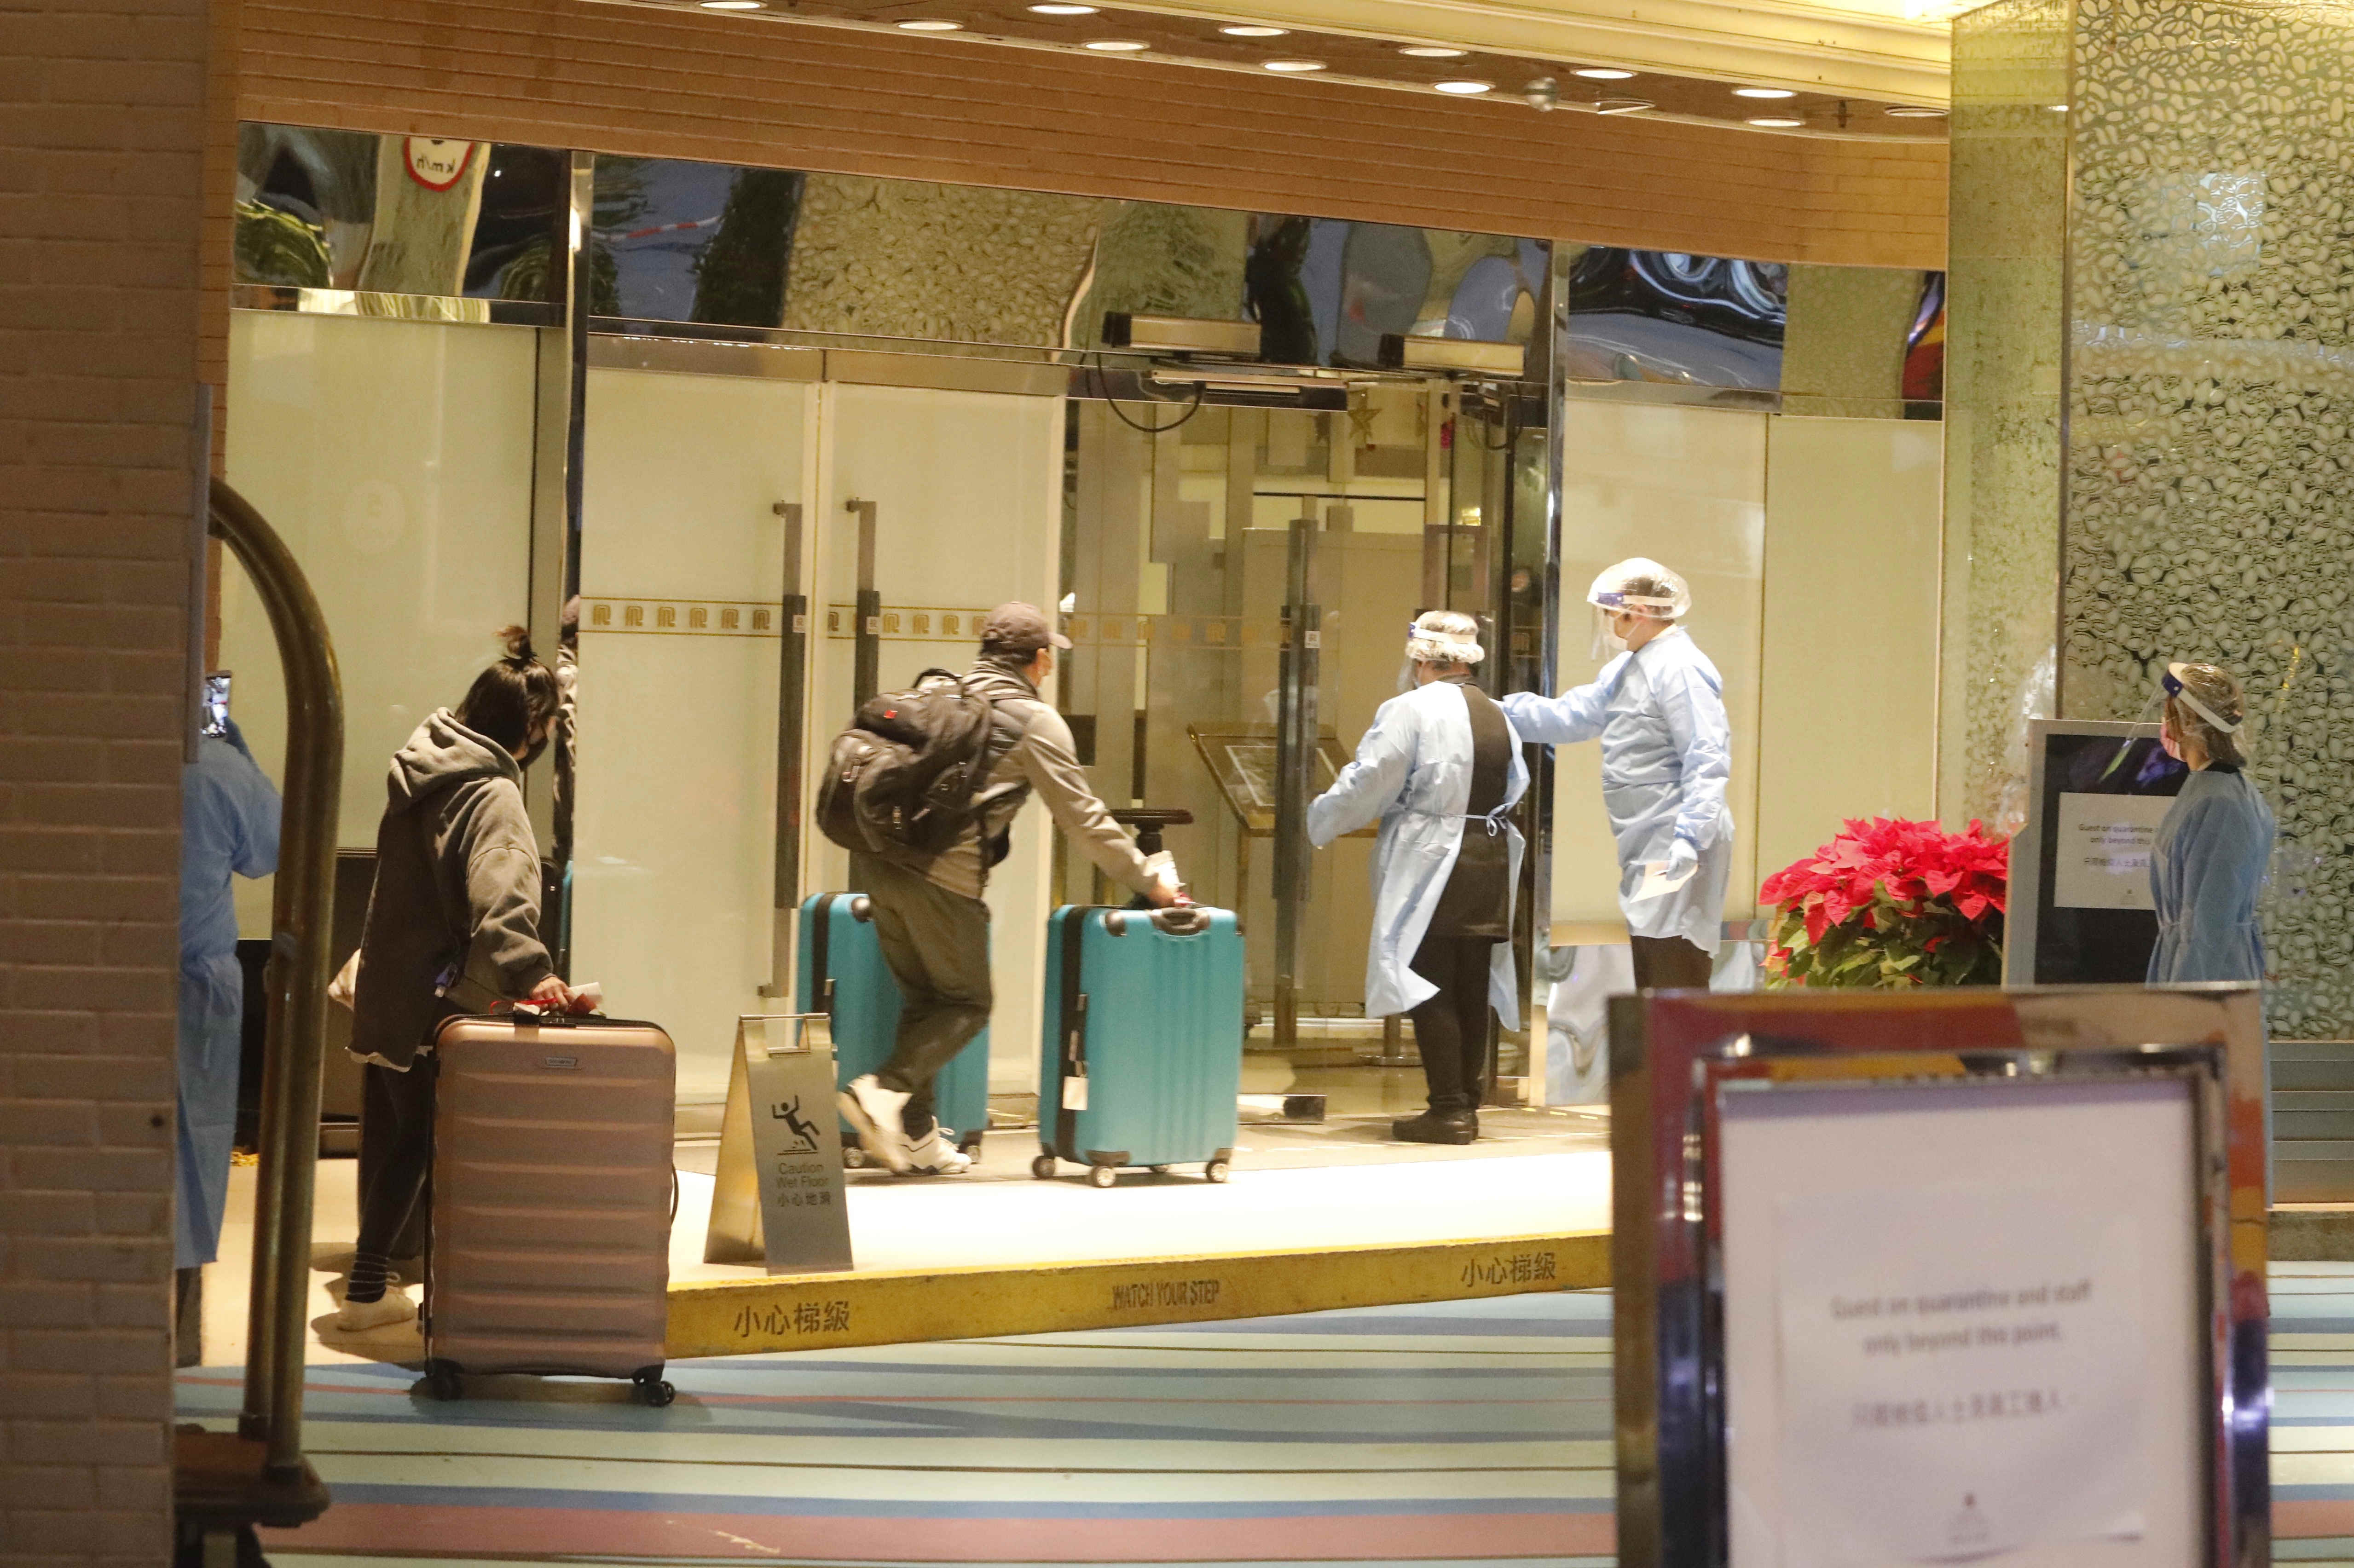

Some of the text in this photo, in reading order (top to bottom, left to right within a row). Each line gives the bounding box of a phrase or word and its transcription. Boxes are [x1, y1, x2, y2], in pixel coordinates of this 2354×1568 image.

[778, 1162, 825, 1175] Caution
[776, 1176, 829, 1189] Wet Floor
[777, 1192, 832, 1207] 小心地滑
[1112, 1279, 1220, 1310] WATCH YOUR STEP
